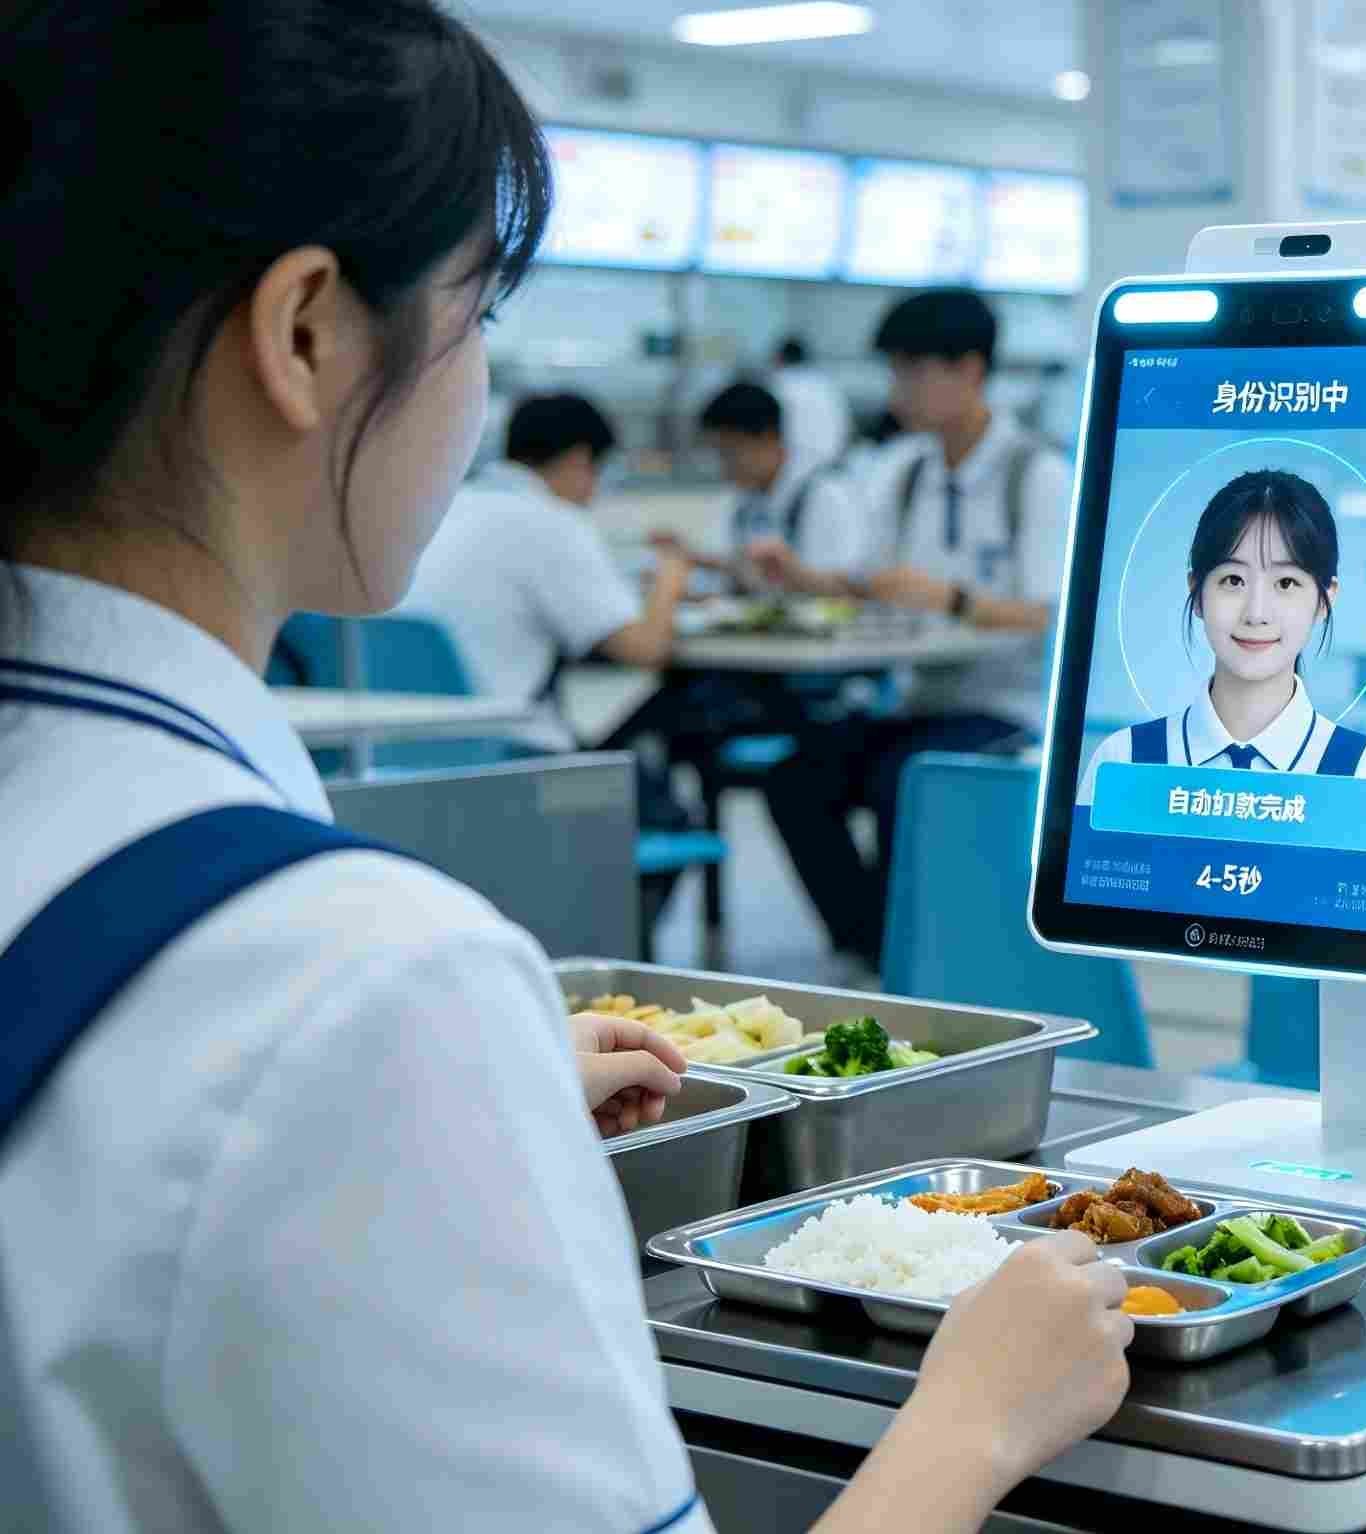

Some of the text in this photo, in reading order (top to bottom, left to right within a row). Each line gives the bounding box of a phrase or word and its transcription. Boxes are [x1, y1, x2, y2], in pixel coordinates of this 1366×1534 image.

[1212, 380, 1348, 413] 身份识别中
[1195, 864, 1263, 895] 4-5秒
